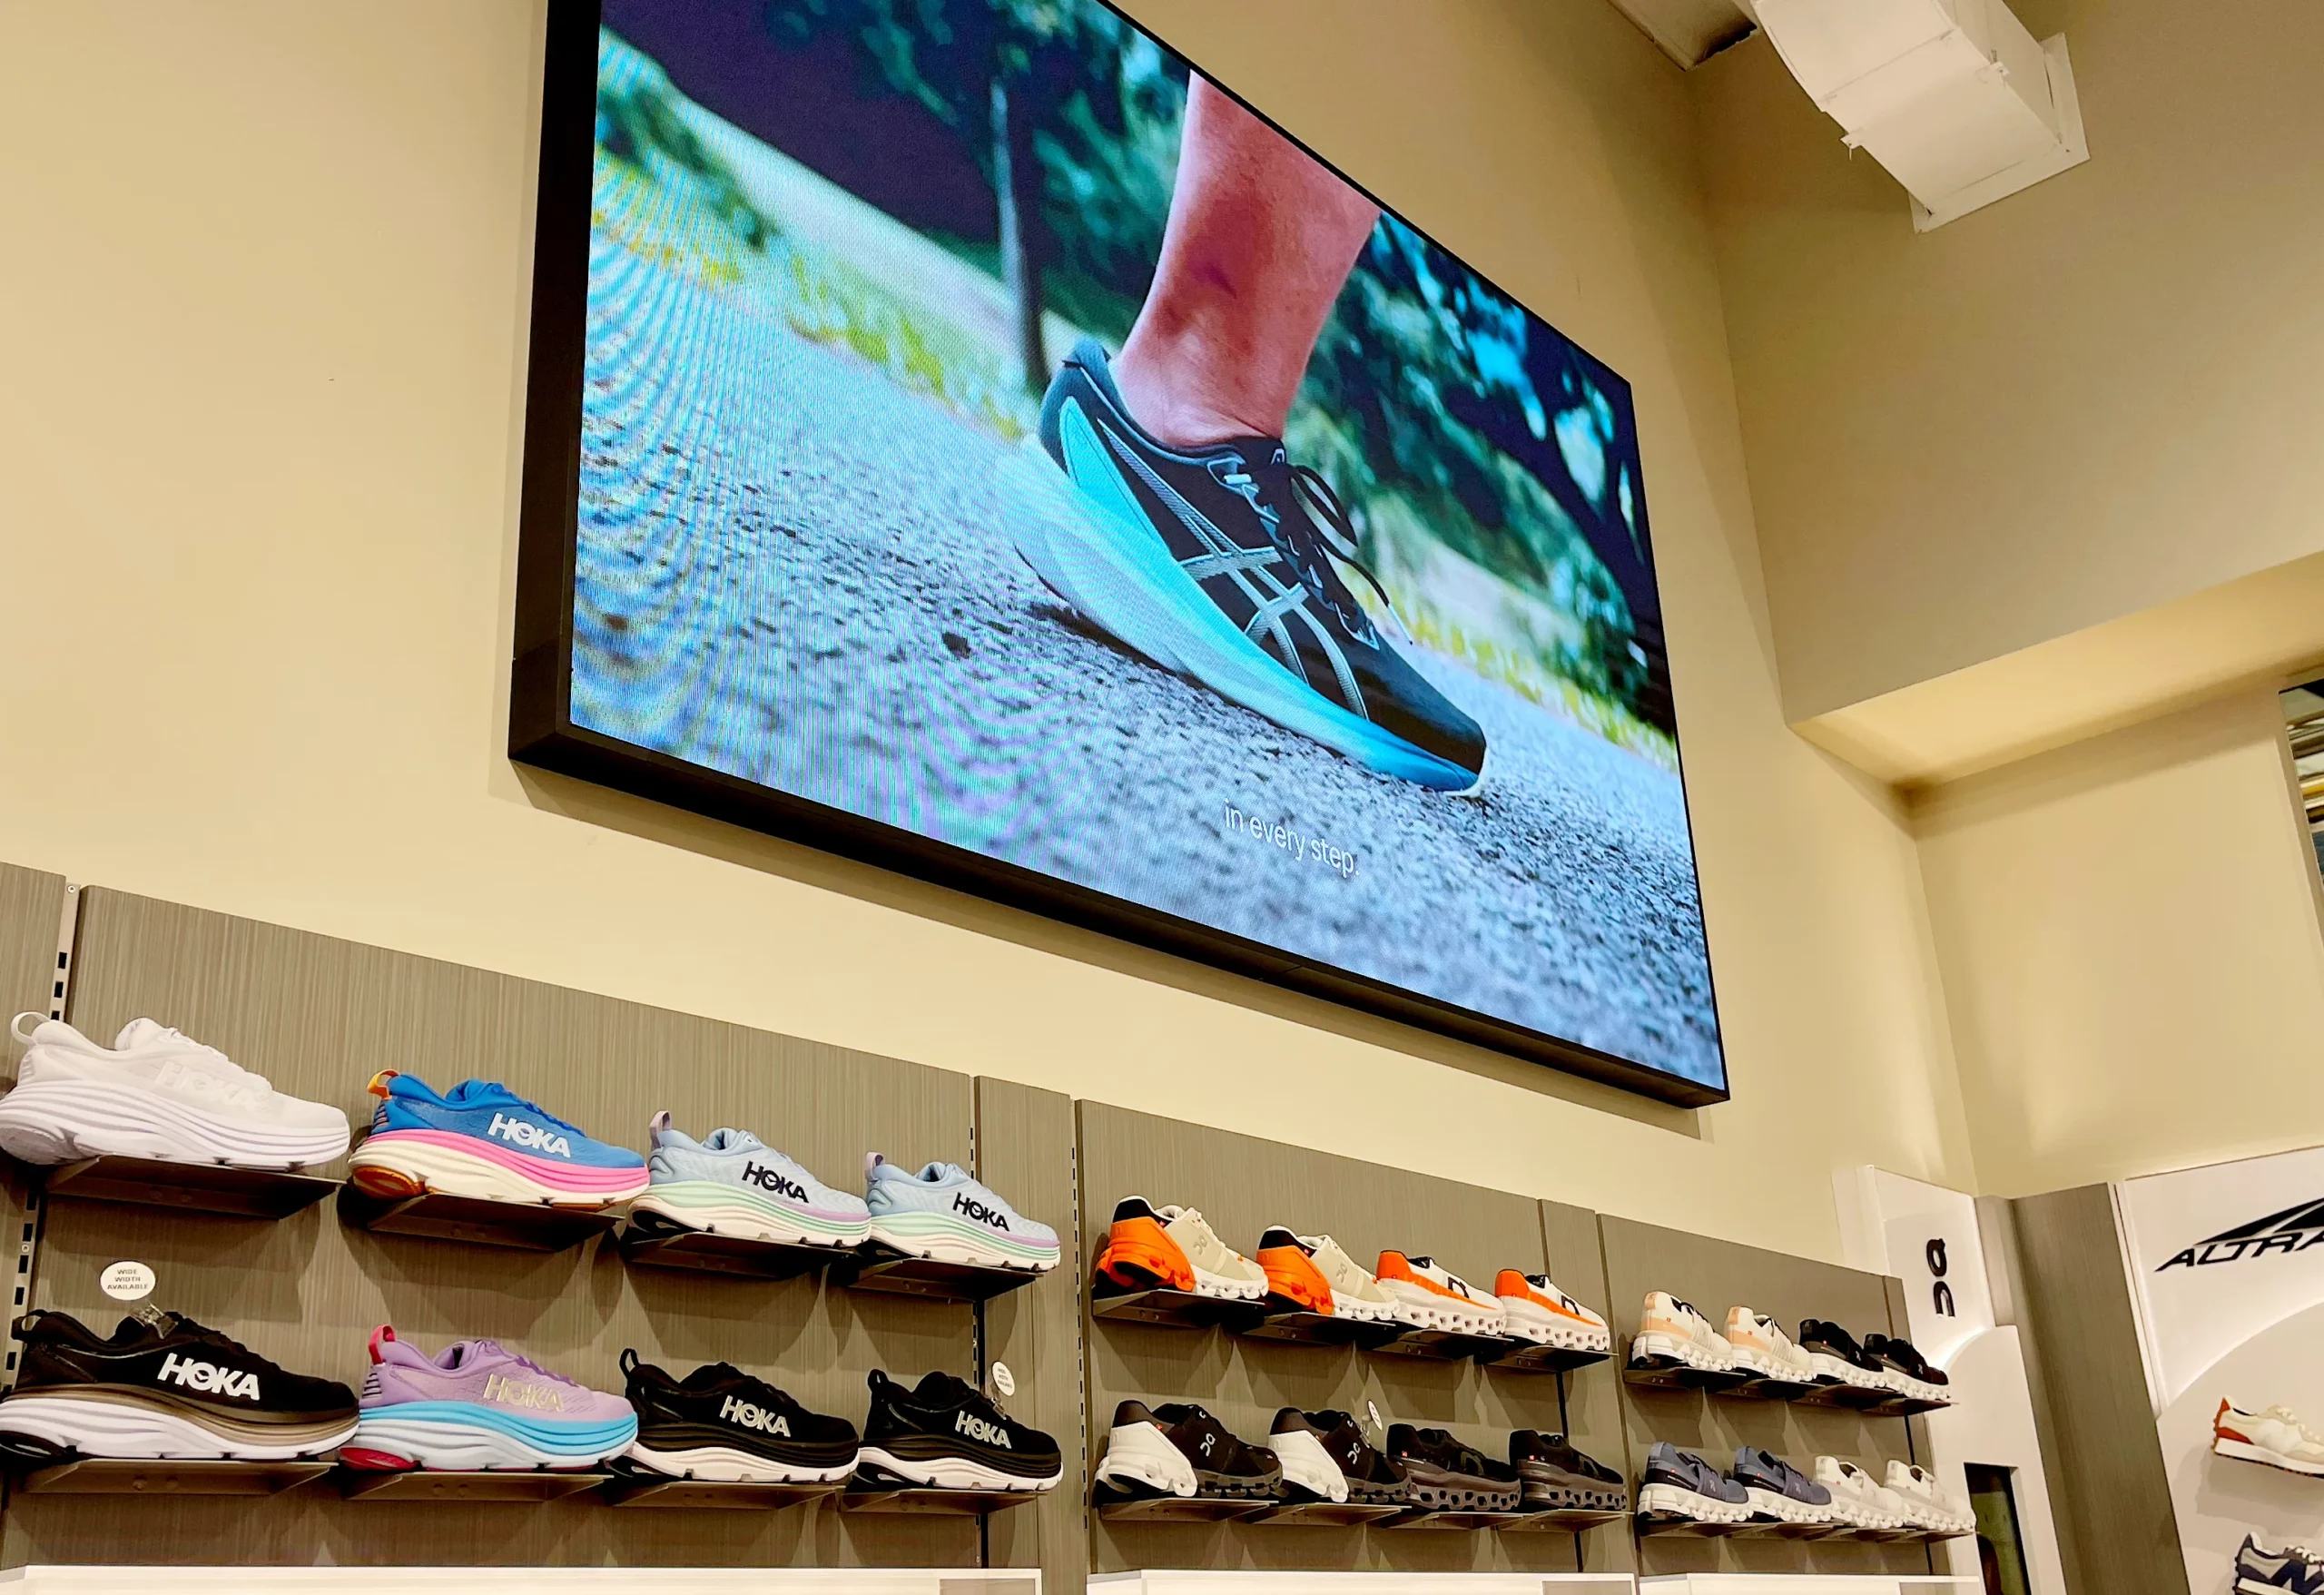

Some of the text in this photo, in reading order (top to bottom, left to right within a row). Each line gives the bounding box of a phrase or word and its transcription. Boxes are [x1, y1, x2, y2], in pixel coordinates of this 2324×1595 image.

[1225, 798, 1360, 879] in every step.
[155, 1059, 274, 1113] HOKA
[487, 1112, 571, 1158] HOKA
[742, 1160, 810, 1204] HOKA
[953, 1192, 1009, 1232] HOKA
[157, 1353, 261, 1401] HOKA
[483, 1373, 565, 1413] HOKA
[719, 1394, 792, 1438] HOKA
[954, 1410, 1011, 1450] HOKA
